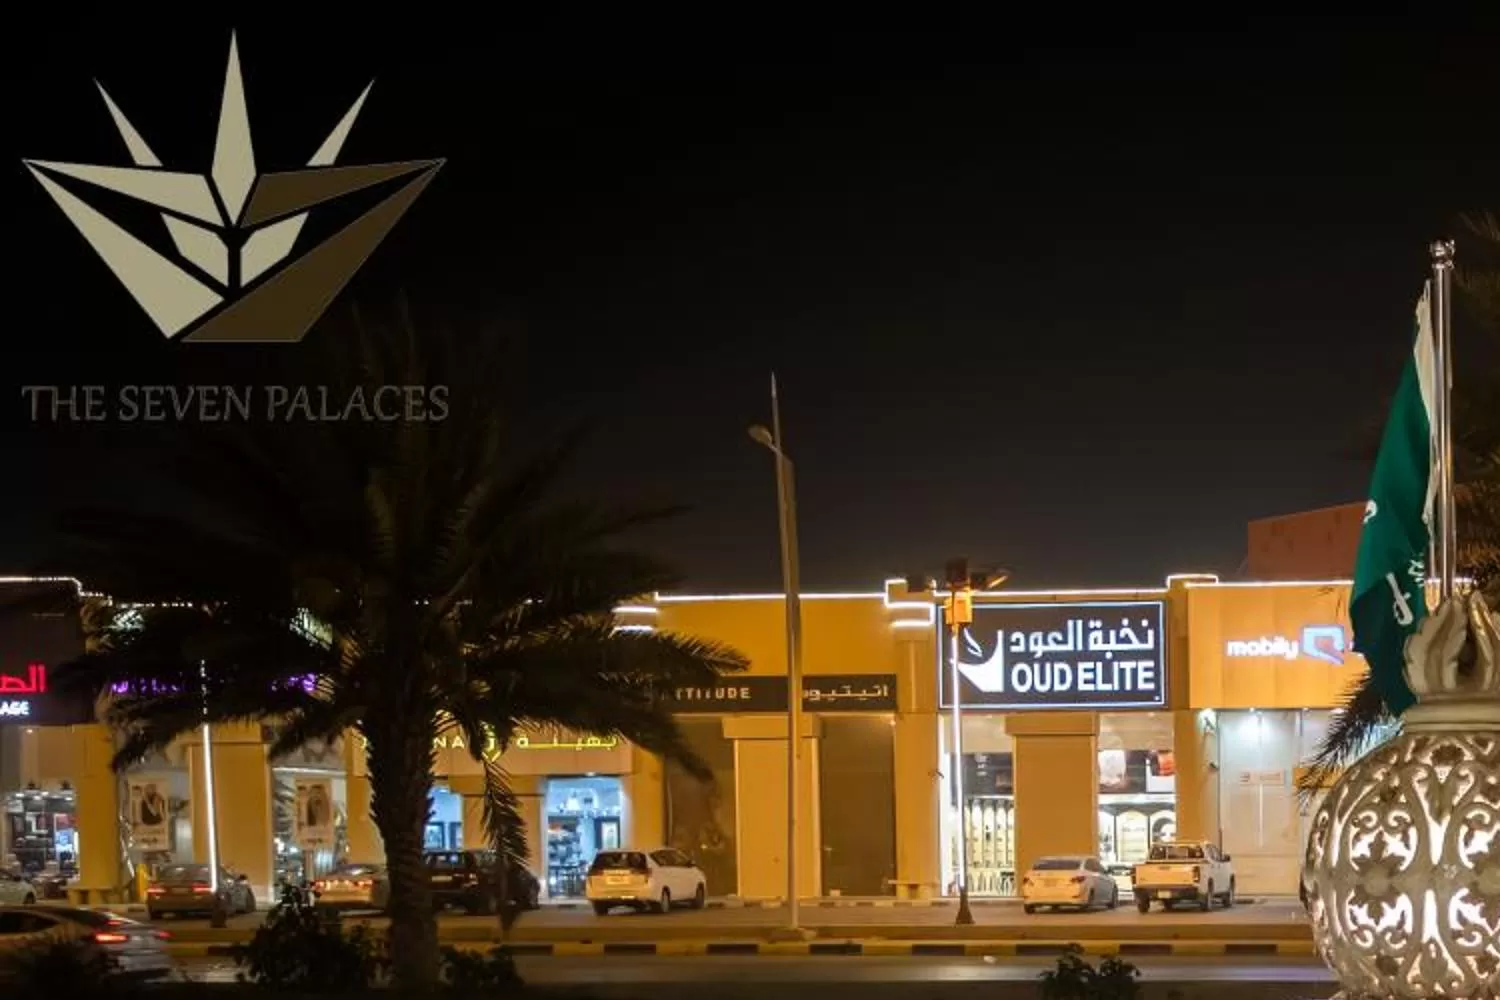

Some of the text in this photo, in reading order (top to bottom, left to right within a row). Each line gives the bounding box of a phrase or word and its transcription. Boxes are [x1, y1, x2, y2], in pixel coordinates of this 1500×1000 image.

[1010, 618, 1155, 659] نخبة العود
[1227, 636, 1299, 660] mobily
[1011, 661, 1155, 692] OUD ELITE
